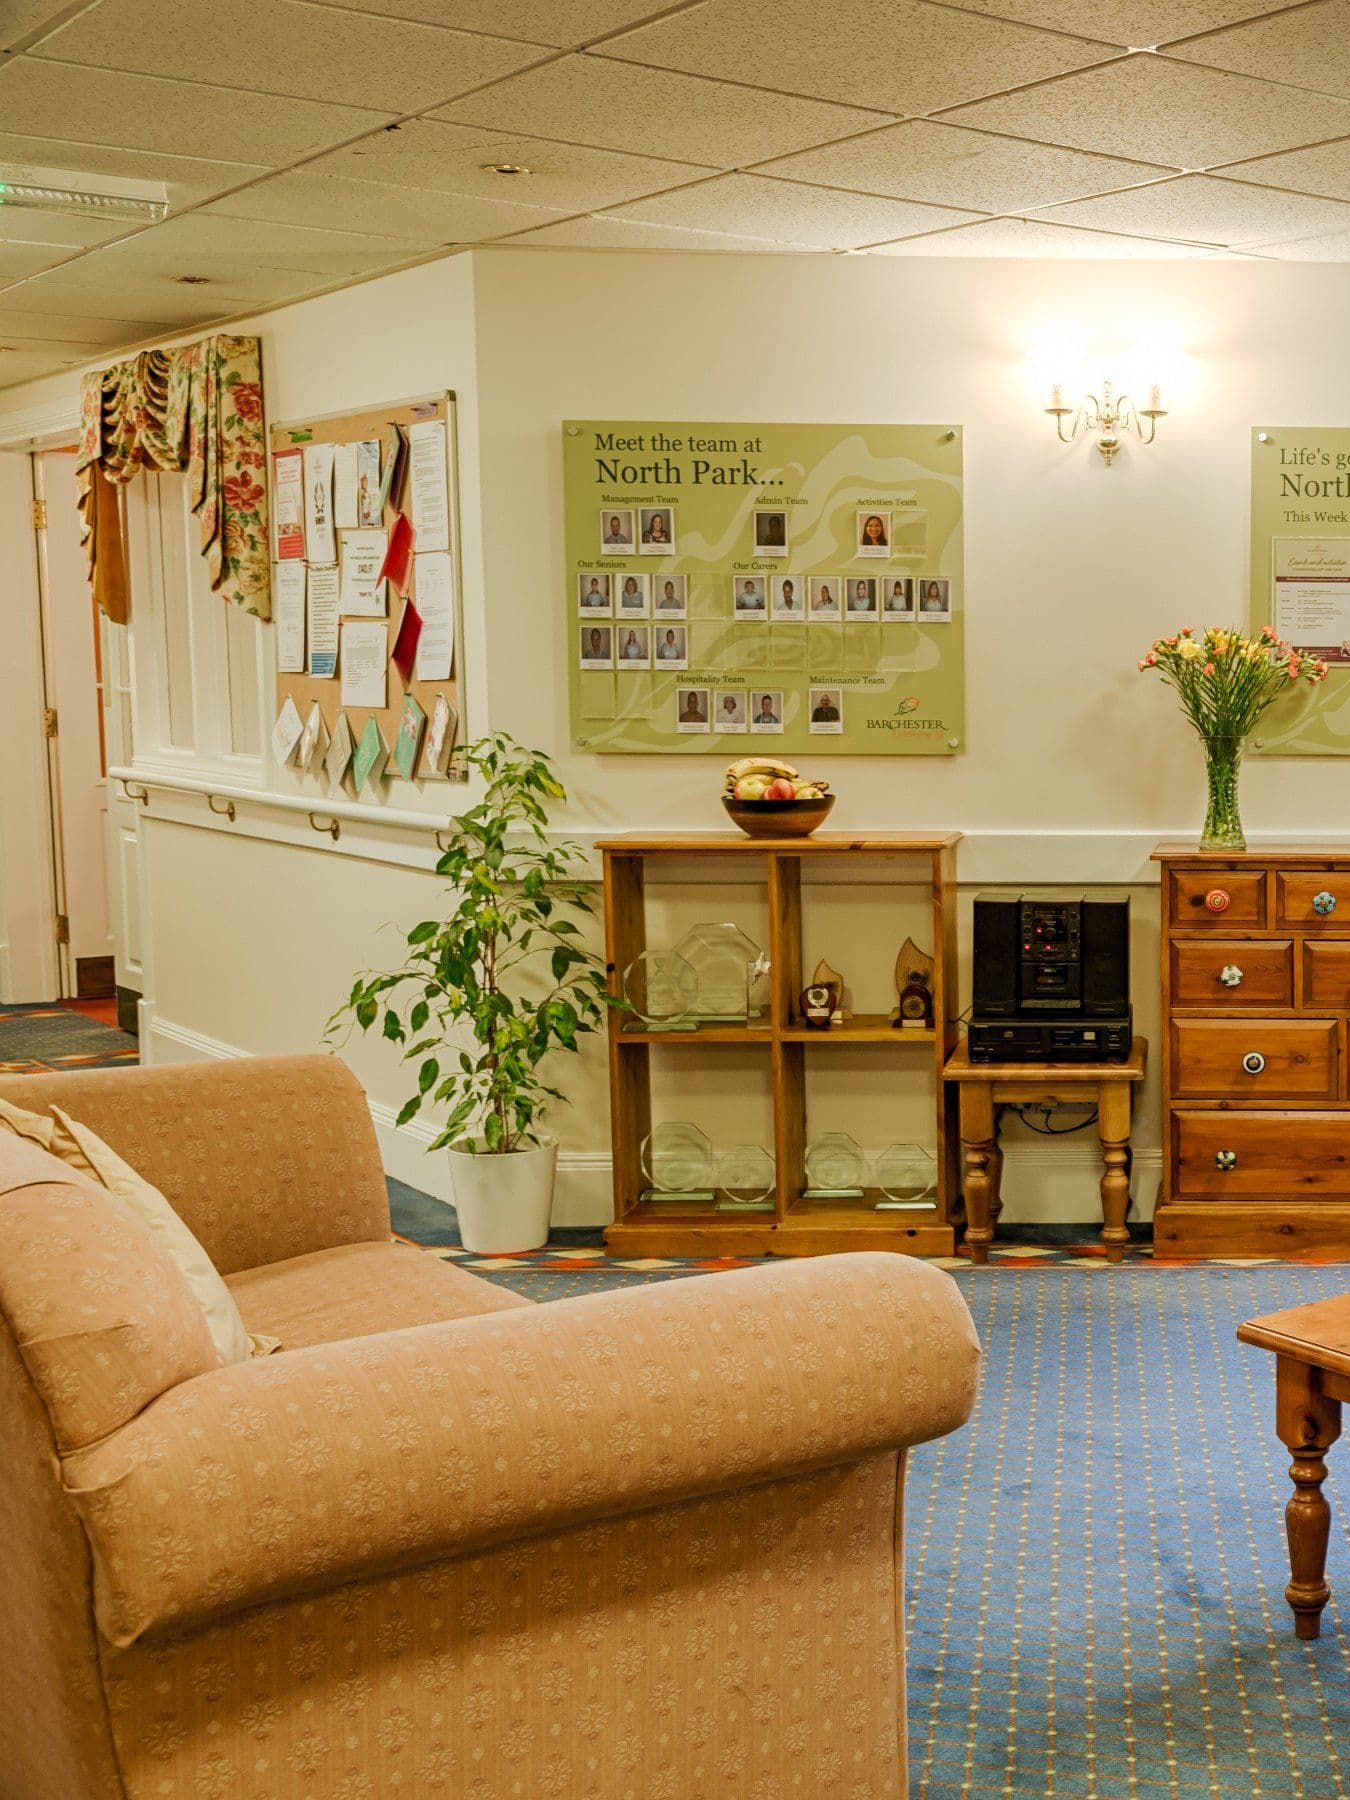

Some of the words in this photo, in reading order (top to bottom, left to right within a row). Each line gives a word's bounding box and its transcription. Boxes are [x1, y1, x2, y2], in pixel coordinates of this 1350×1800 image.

[595, 433, 645, 451] Meet
[651, 433, 682, 452] the
[688, 436, 737, 453] team
[744, 437, 763, 453] at
[1279, 448, 1330, 465] Life's
[594, 458, 682, 485] North
[691, 459, 784, 486] Park...
[601, 494, 654, 505] Management
[655, 495, 679, 504] Team
[754, 496, 783, 505] Admin
[784, 496, 809, 505] Team
[856, 498, 893, 506] Activities
[896, 498, 917, 506] Team
[1283, 510, 1311, 523] This
[1312, 510, 1349, 523] Week
[577, 560, 594, 569] Our
[596, 560, 627, 569] Seniors
[733, 562, 750, 570] Our
[751, 562, 778, 570] Carers
[676, 675, 721, 685] Hospitality
[721, 675, 745, 684] Team
[809, 675, 861, 684] Maintenance
[866, 719, 949, 731] BARCHESTER
